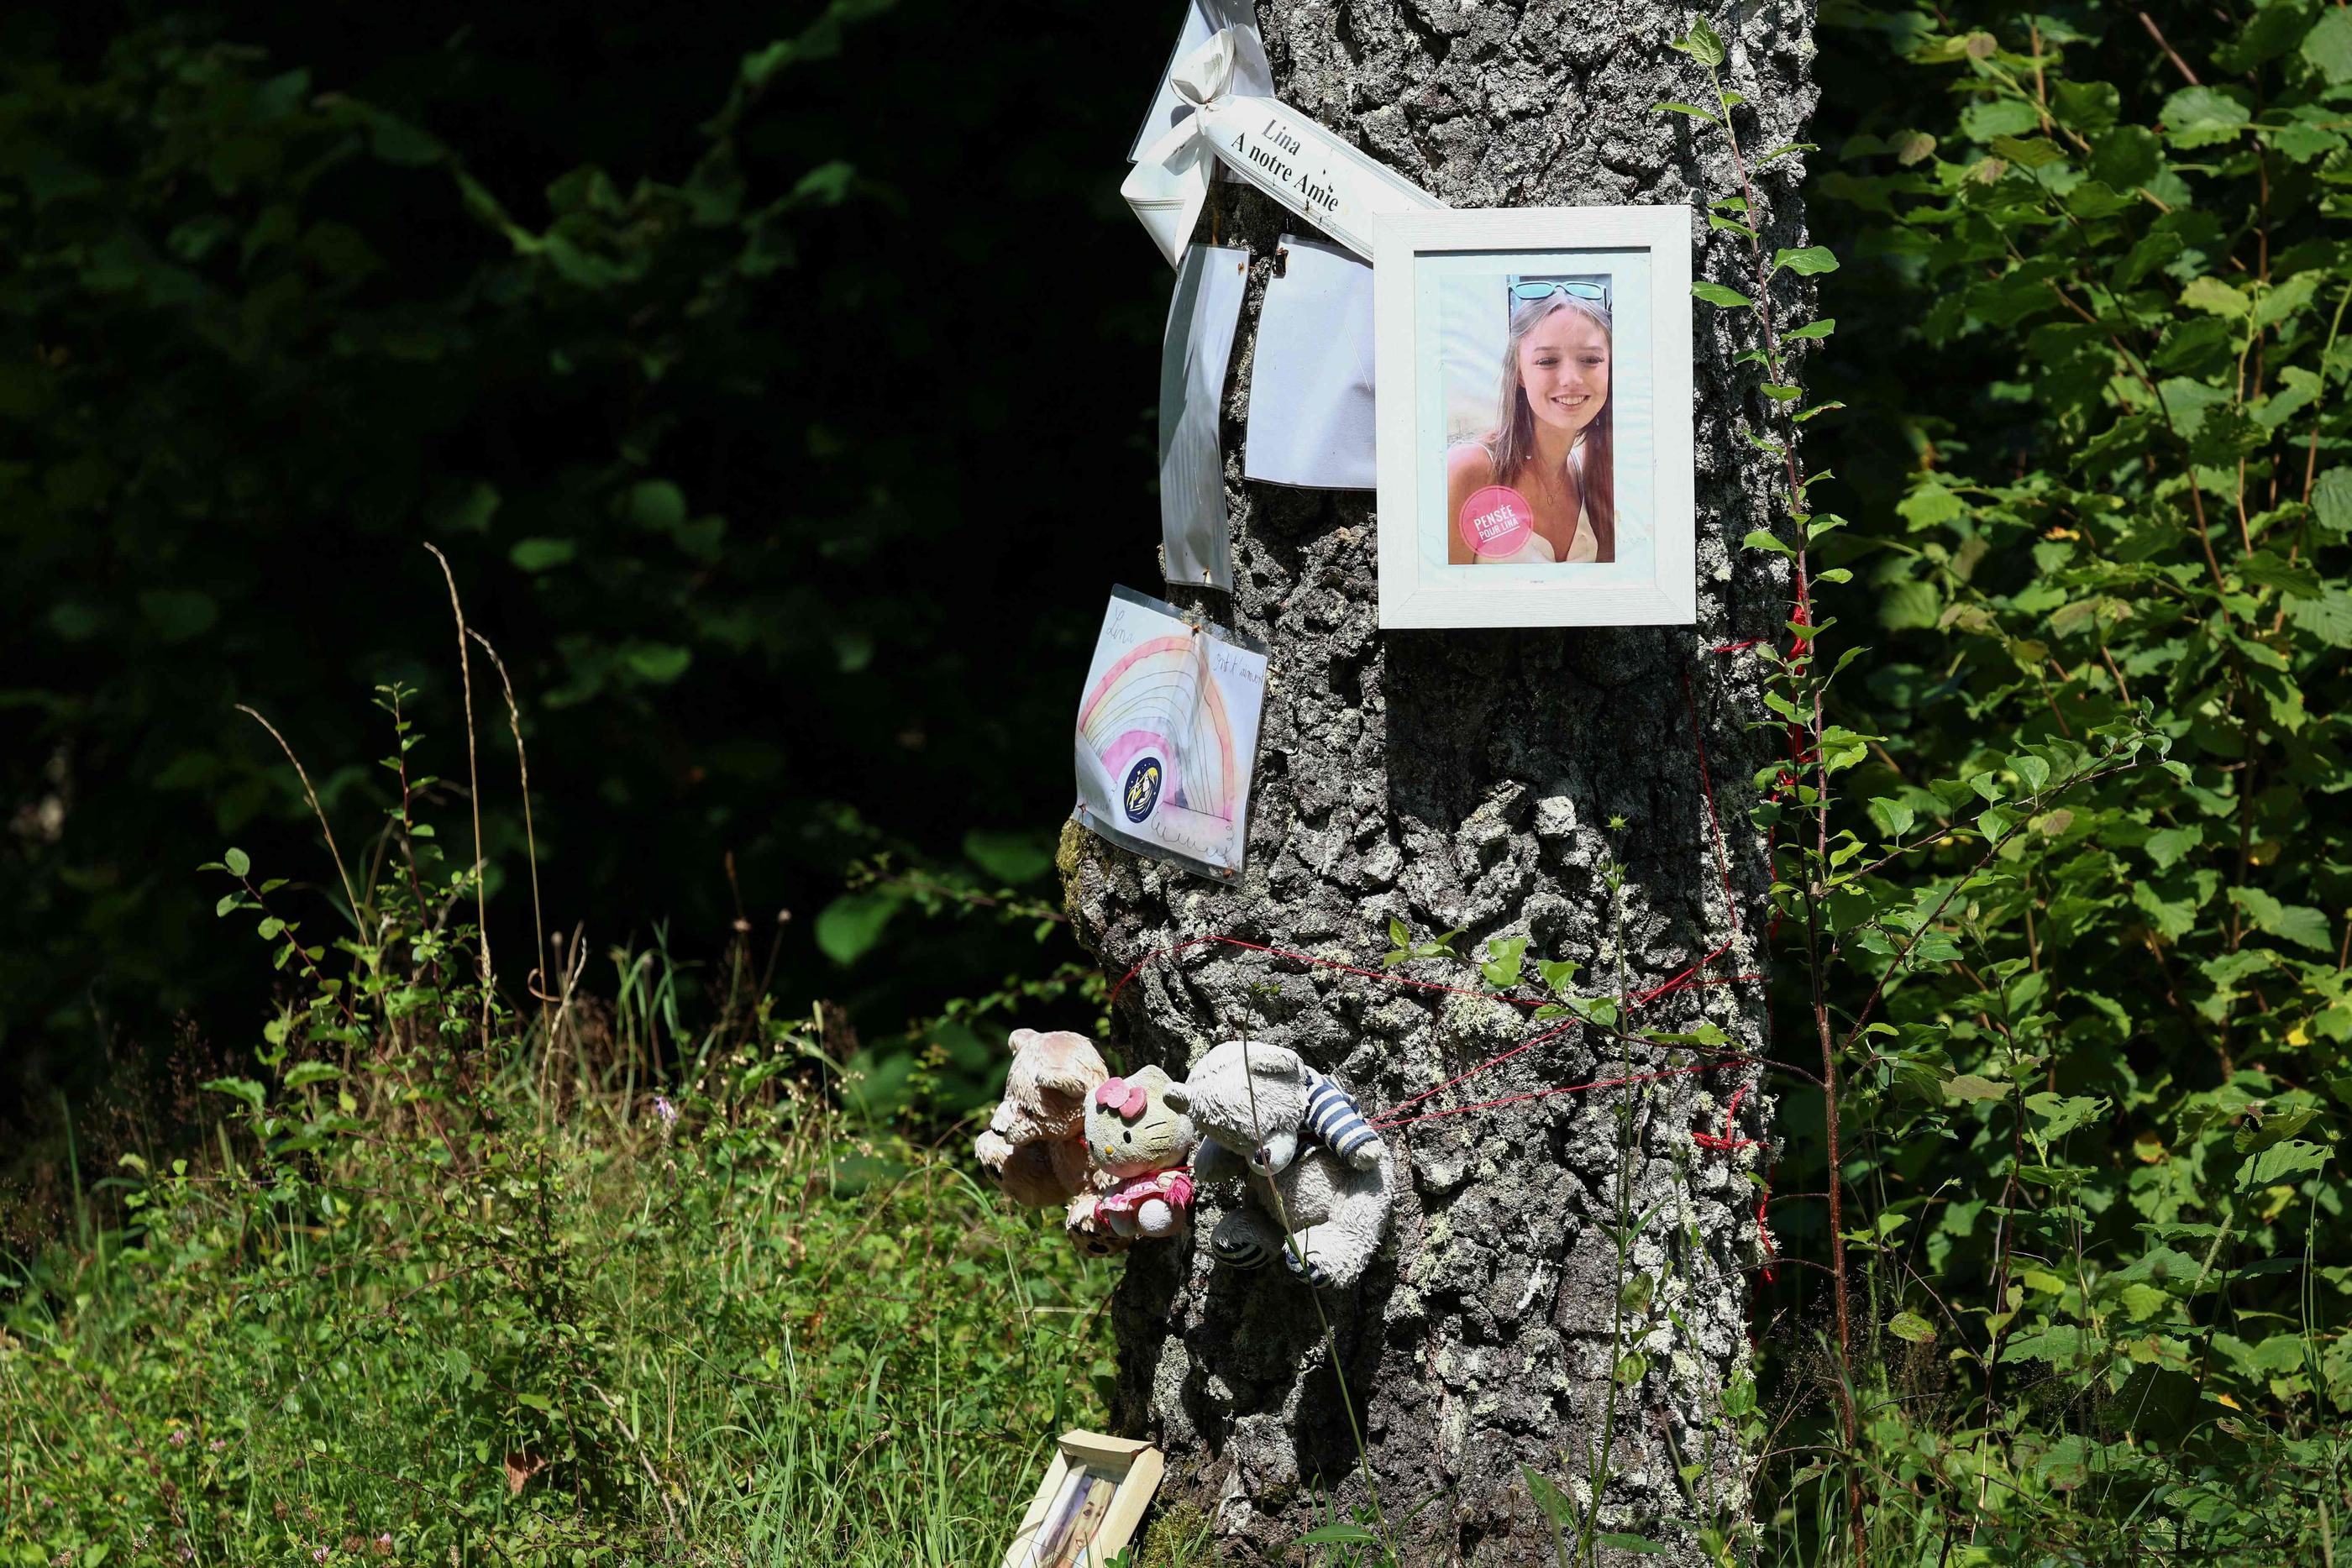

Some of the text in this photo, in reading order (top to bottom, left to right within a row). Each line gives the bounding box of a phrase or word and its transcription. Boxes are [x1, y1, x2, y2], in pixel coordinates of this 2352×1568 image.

[1262, 119, 1301, 155] Lina
[1231, 132, 1338, 212] A notre Amie
[1473, 504, 1515, 531] PENSÉE
[1478, 517, 1519, 540] POUR LINA
